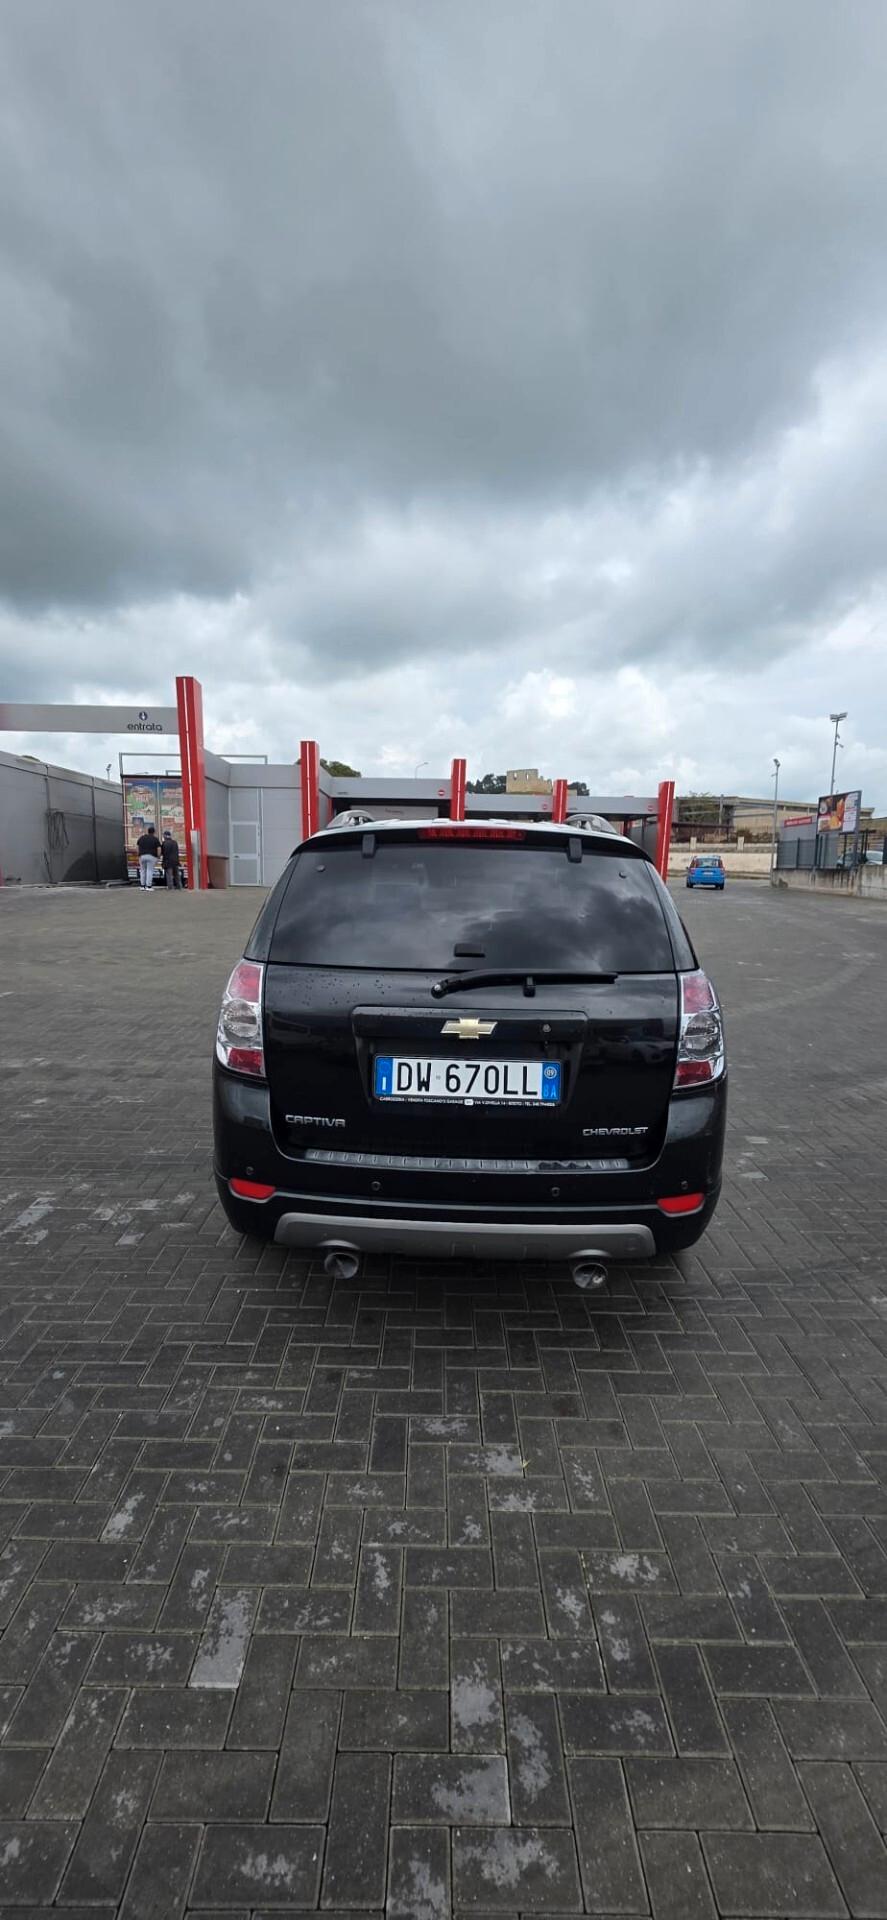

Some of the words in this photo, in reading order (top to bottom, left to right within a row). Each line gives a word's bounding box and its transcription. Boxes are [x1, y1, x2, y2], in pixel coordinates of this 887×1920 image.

[127, 723, 163, 731] entrata
[397, 1062, 432, 1092] DW
[445, 1064, 538, 1096] 670LL
[285, 1114, 346, 1128] CAPTIVA
[583, 1126, 649, 1136] CHEVROLET
